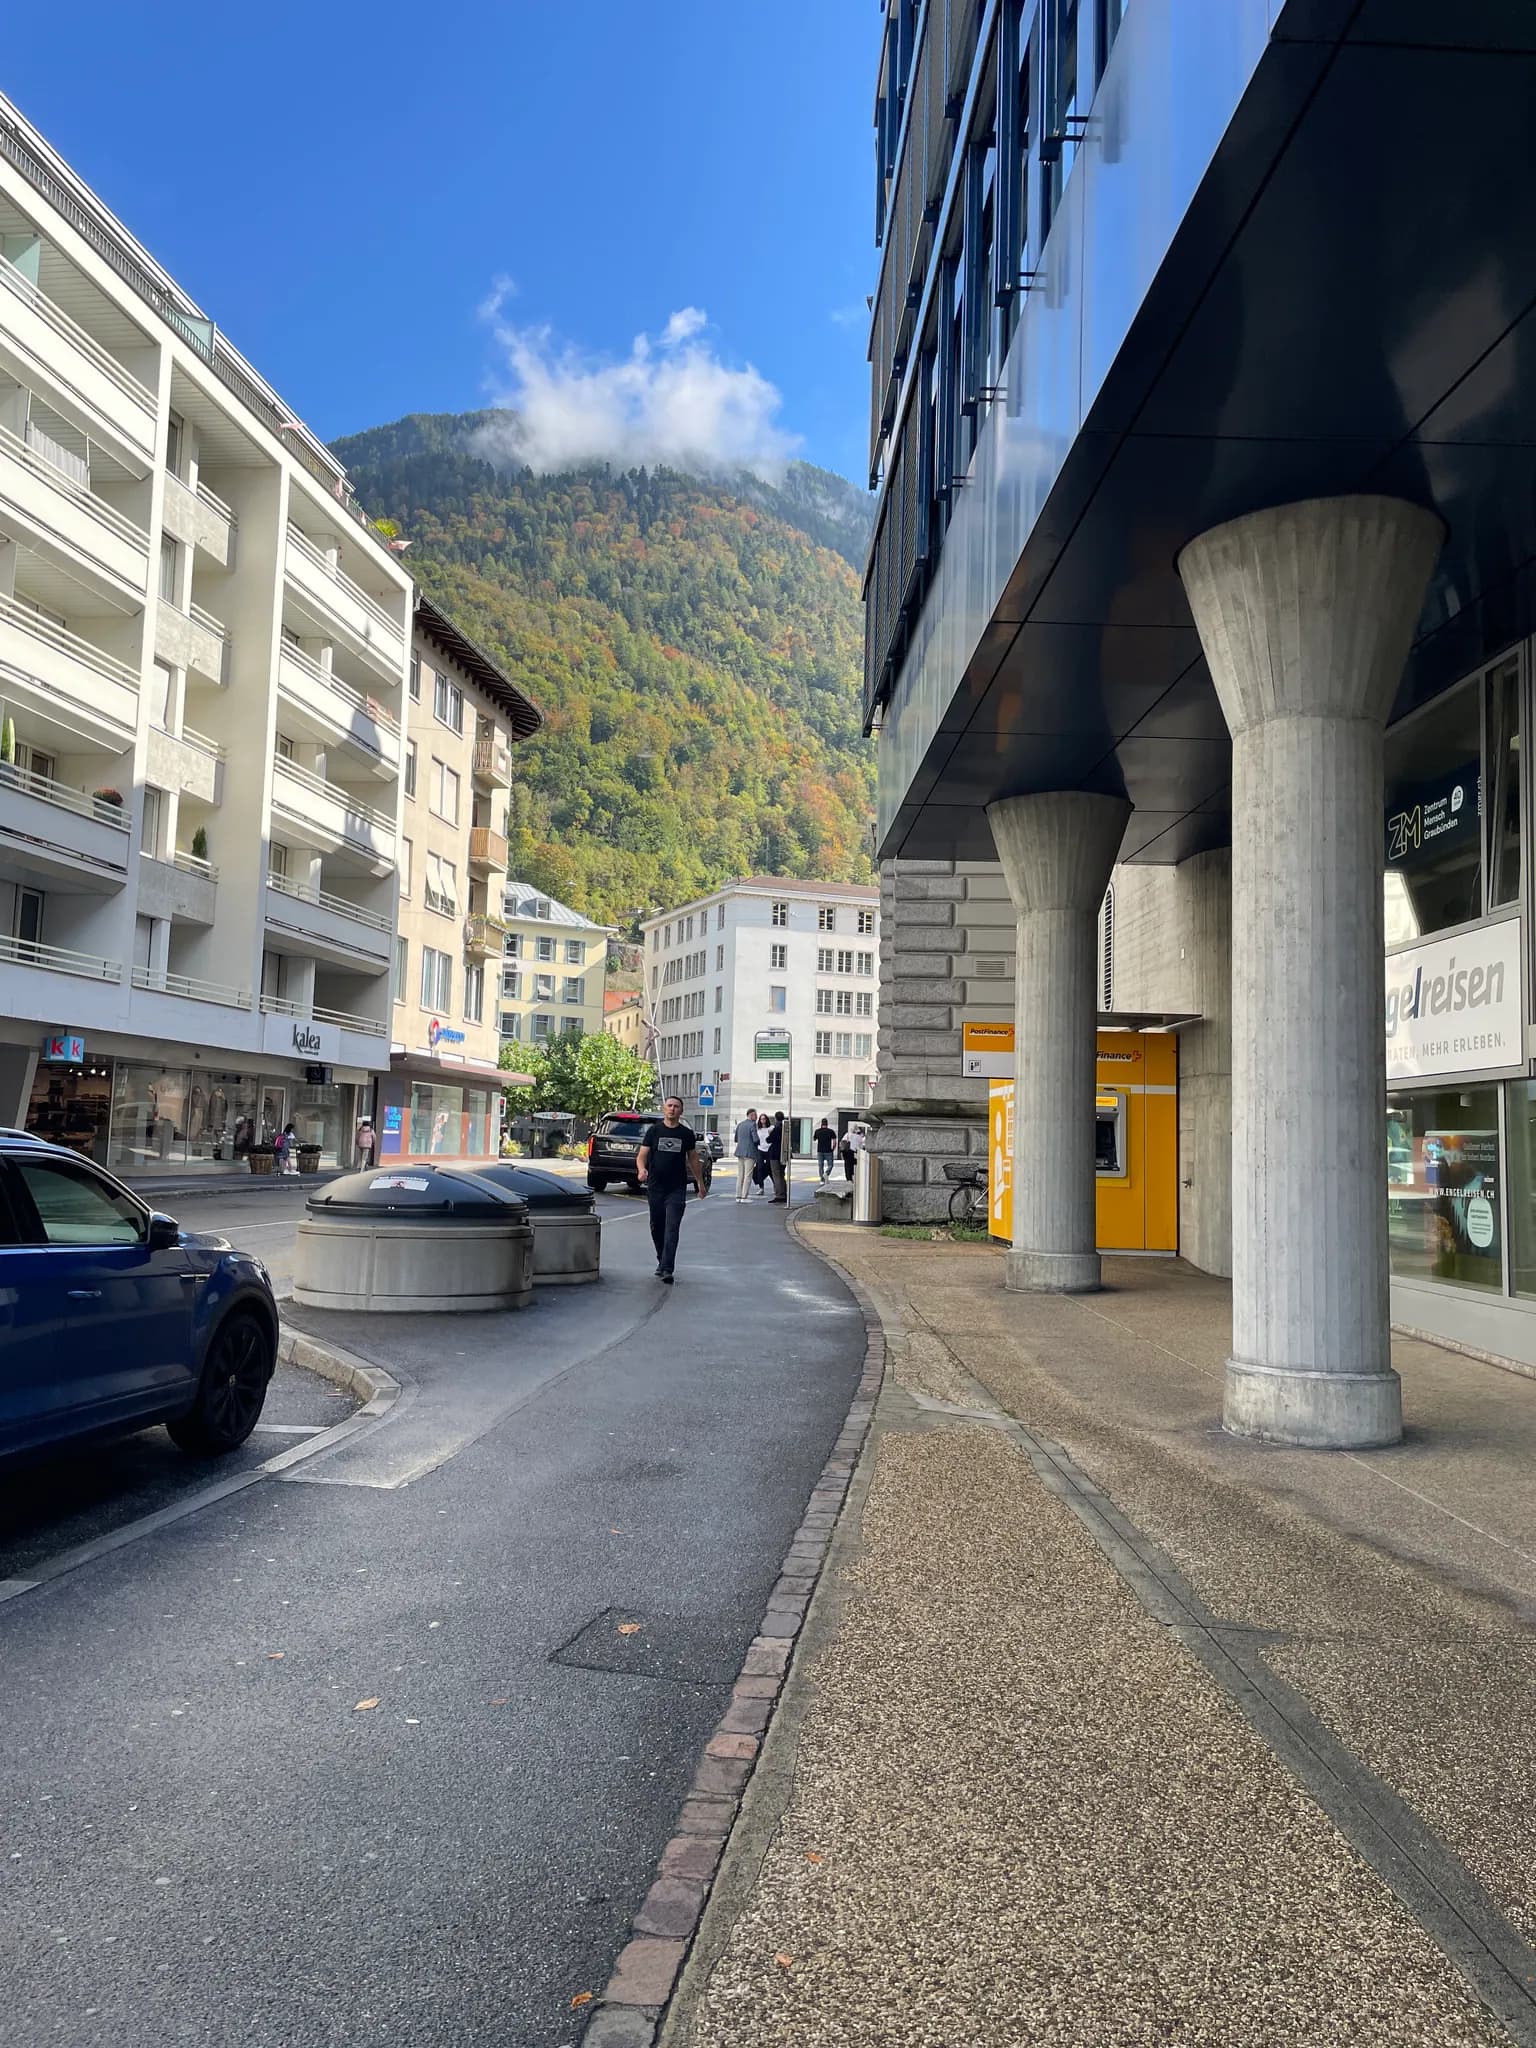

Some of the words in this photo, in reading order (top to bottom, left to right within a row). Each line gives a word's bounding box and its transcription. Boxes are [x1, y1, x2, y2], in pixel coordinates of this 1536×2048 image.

[1423, 797, 1447, 815] Zentrum
[1423, 810, 1446, 828] Mensch
[1423, 818, 1458, 840] Graubünden
[1388, 805, 1421, 860] ZM
[1385, 956, 1505, 1038] gelreisen
[291, 1024, 321, 1053] kalea
[970, 1028, 1009, 1036] PostFinance
[1422, 1040, 1449, 1057] MEHR
[1453, 1032, 1506, 1053] ERLEBEN.
